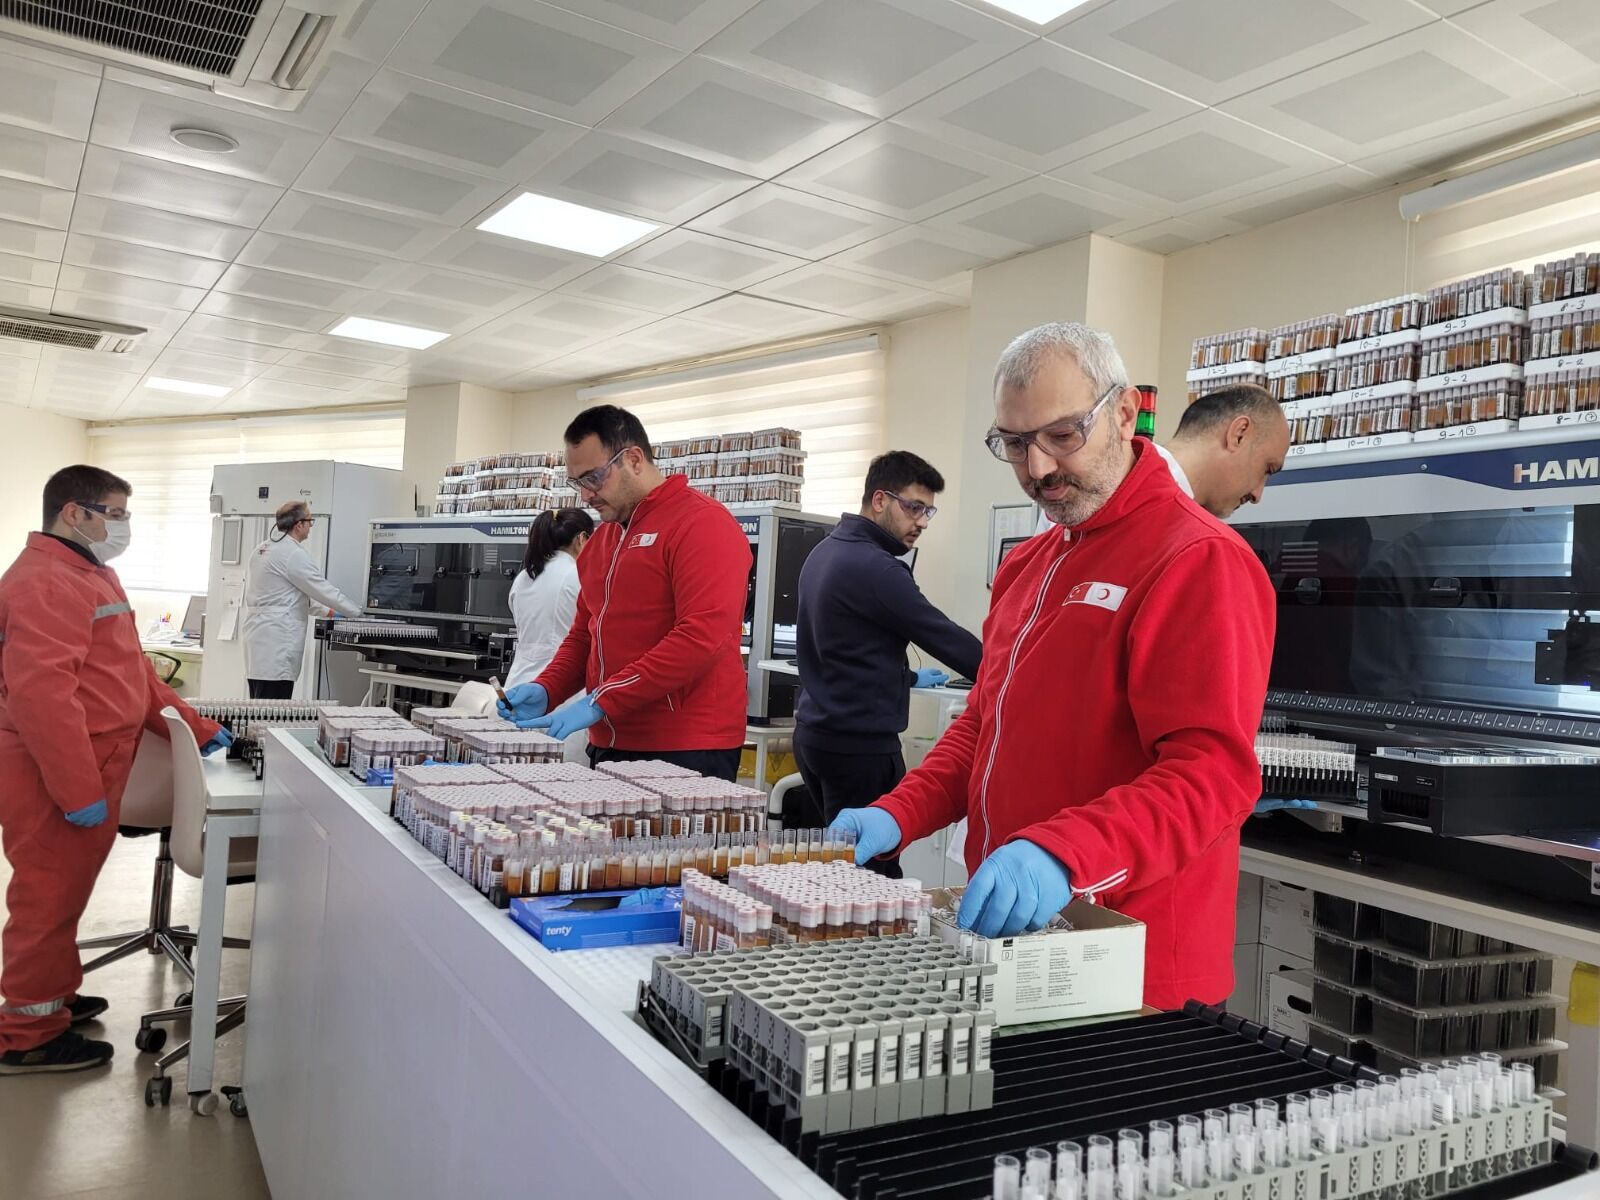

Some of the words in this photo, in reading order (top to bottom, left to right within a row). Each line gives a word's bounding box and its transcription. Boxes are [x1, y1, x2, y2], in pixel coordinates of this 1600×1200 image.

[1442, 373, 1468, 385] 9-2
[1514, 457, 1598, 483] HAM
[490, 526, 529, 535] HAMILTON
